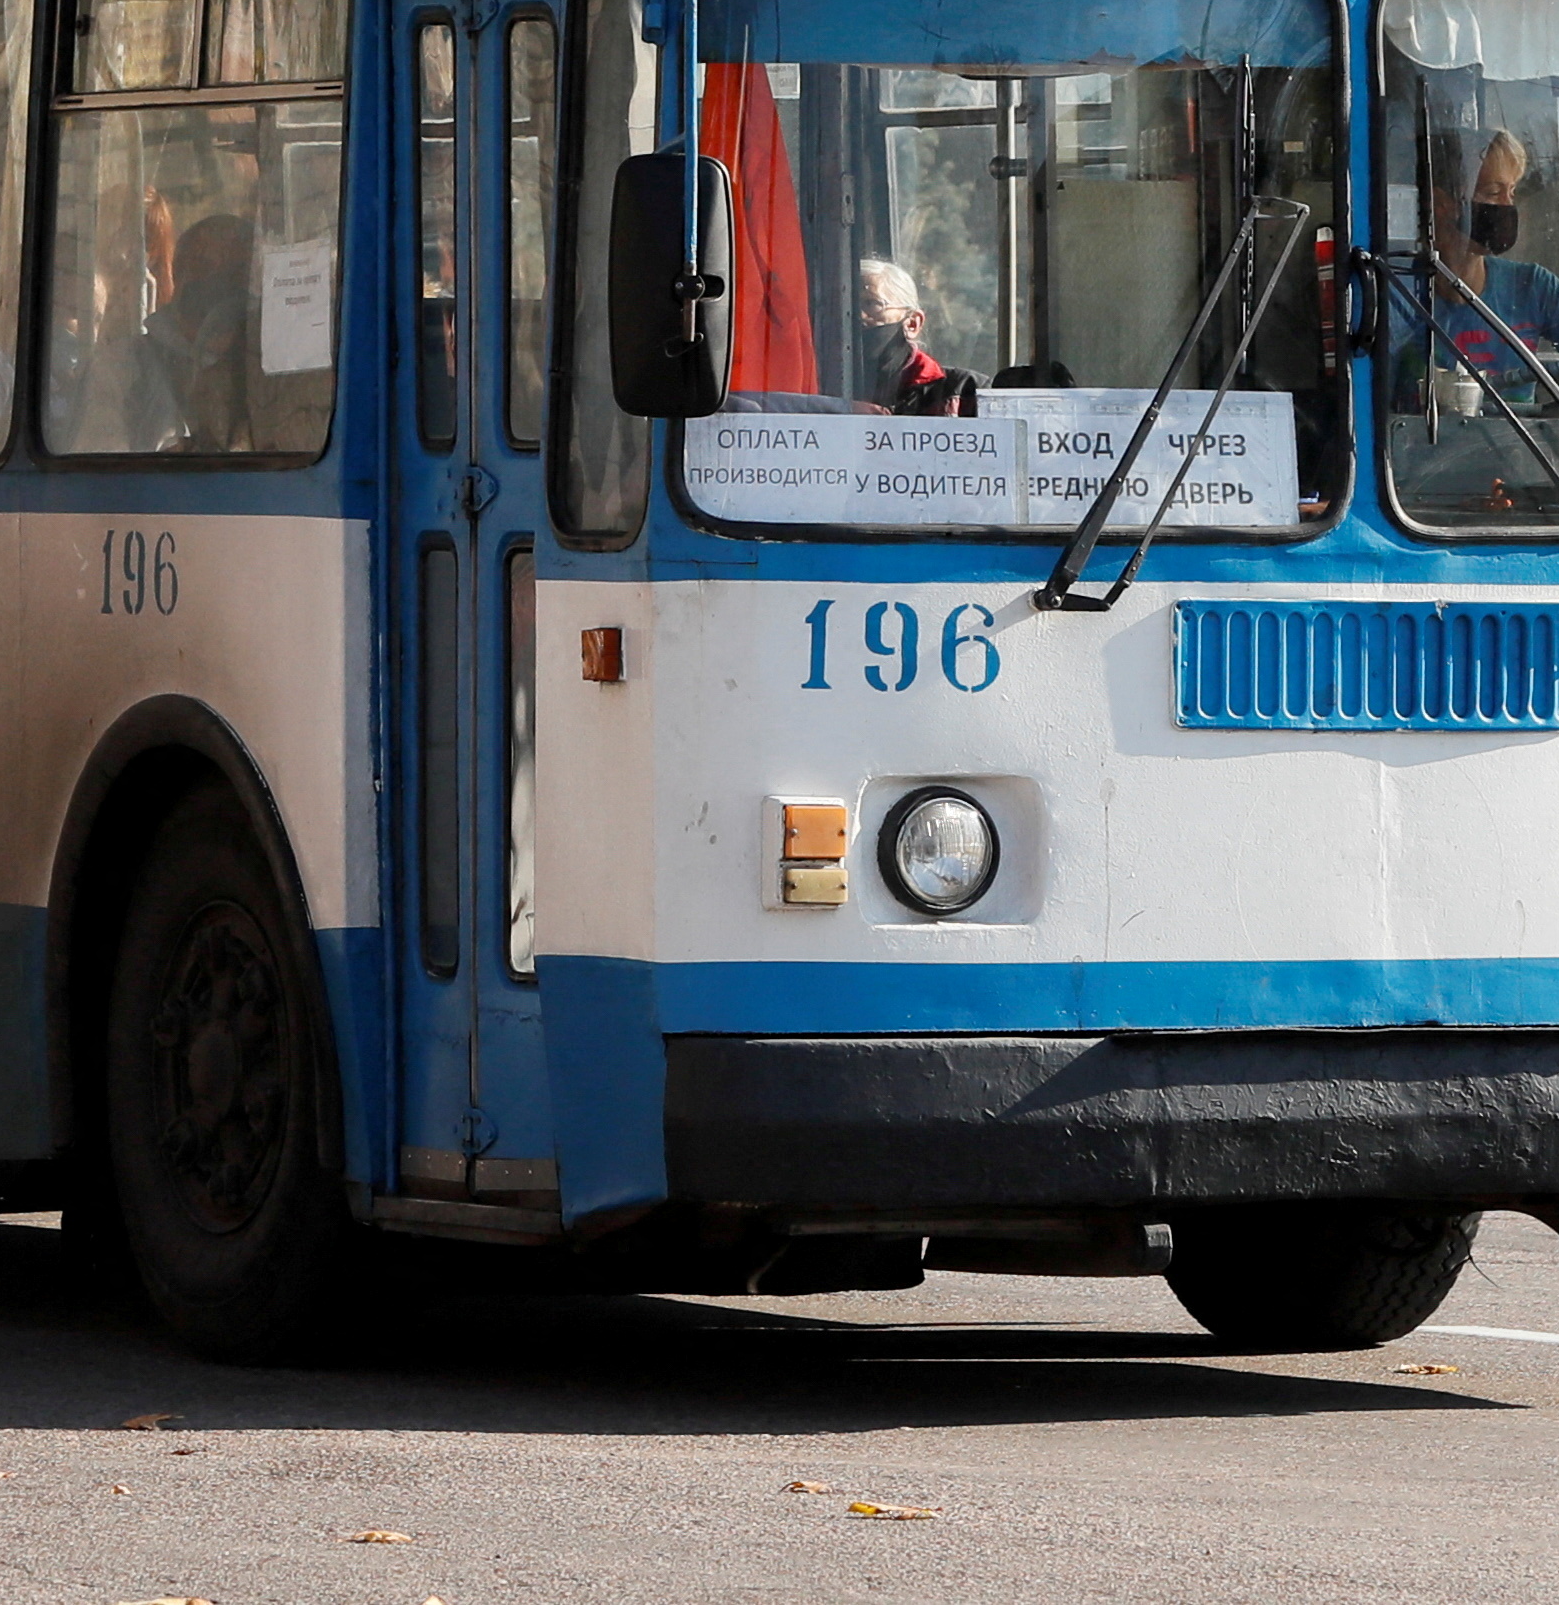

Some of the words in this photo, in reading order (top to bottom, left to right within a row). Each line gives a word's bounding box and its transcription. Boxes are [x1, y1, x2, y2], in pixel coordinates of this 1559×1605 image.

[717, 429, 820, 450] ОПЛАТА
[864, 431, 894, 452] ЗА
[902, 432, 997, 457] ПРОЕЗД
[1038, 432, 1114, 459] ВХОД
[1168, 434, 1246, 456] ЧЕРЕЗ
[690, 468, 848, 487] ПРОИЗВОДИТСЯ
[855, 473, 870, 493] У
[878, 473, 1006, 499] ВОДИТЕЛЯ
[1168, 482, 1254, 509] ДВЕРЬ
[101, 530, 178, 616] 196
[801, 599, 1001, 693] 196
